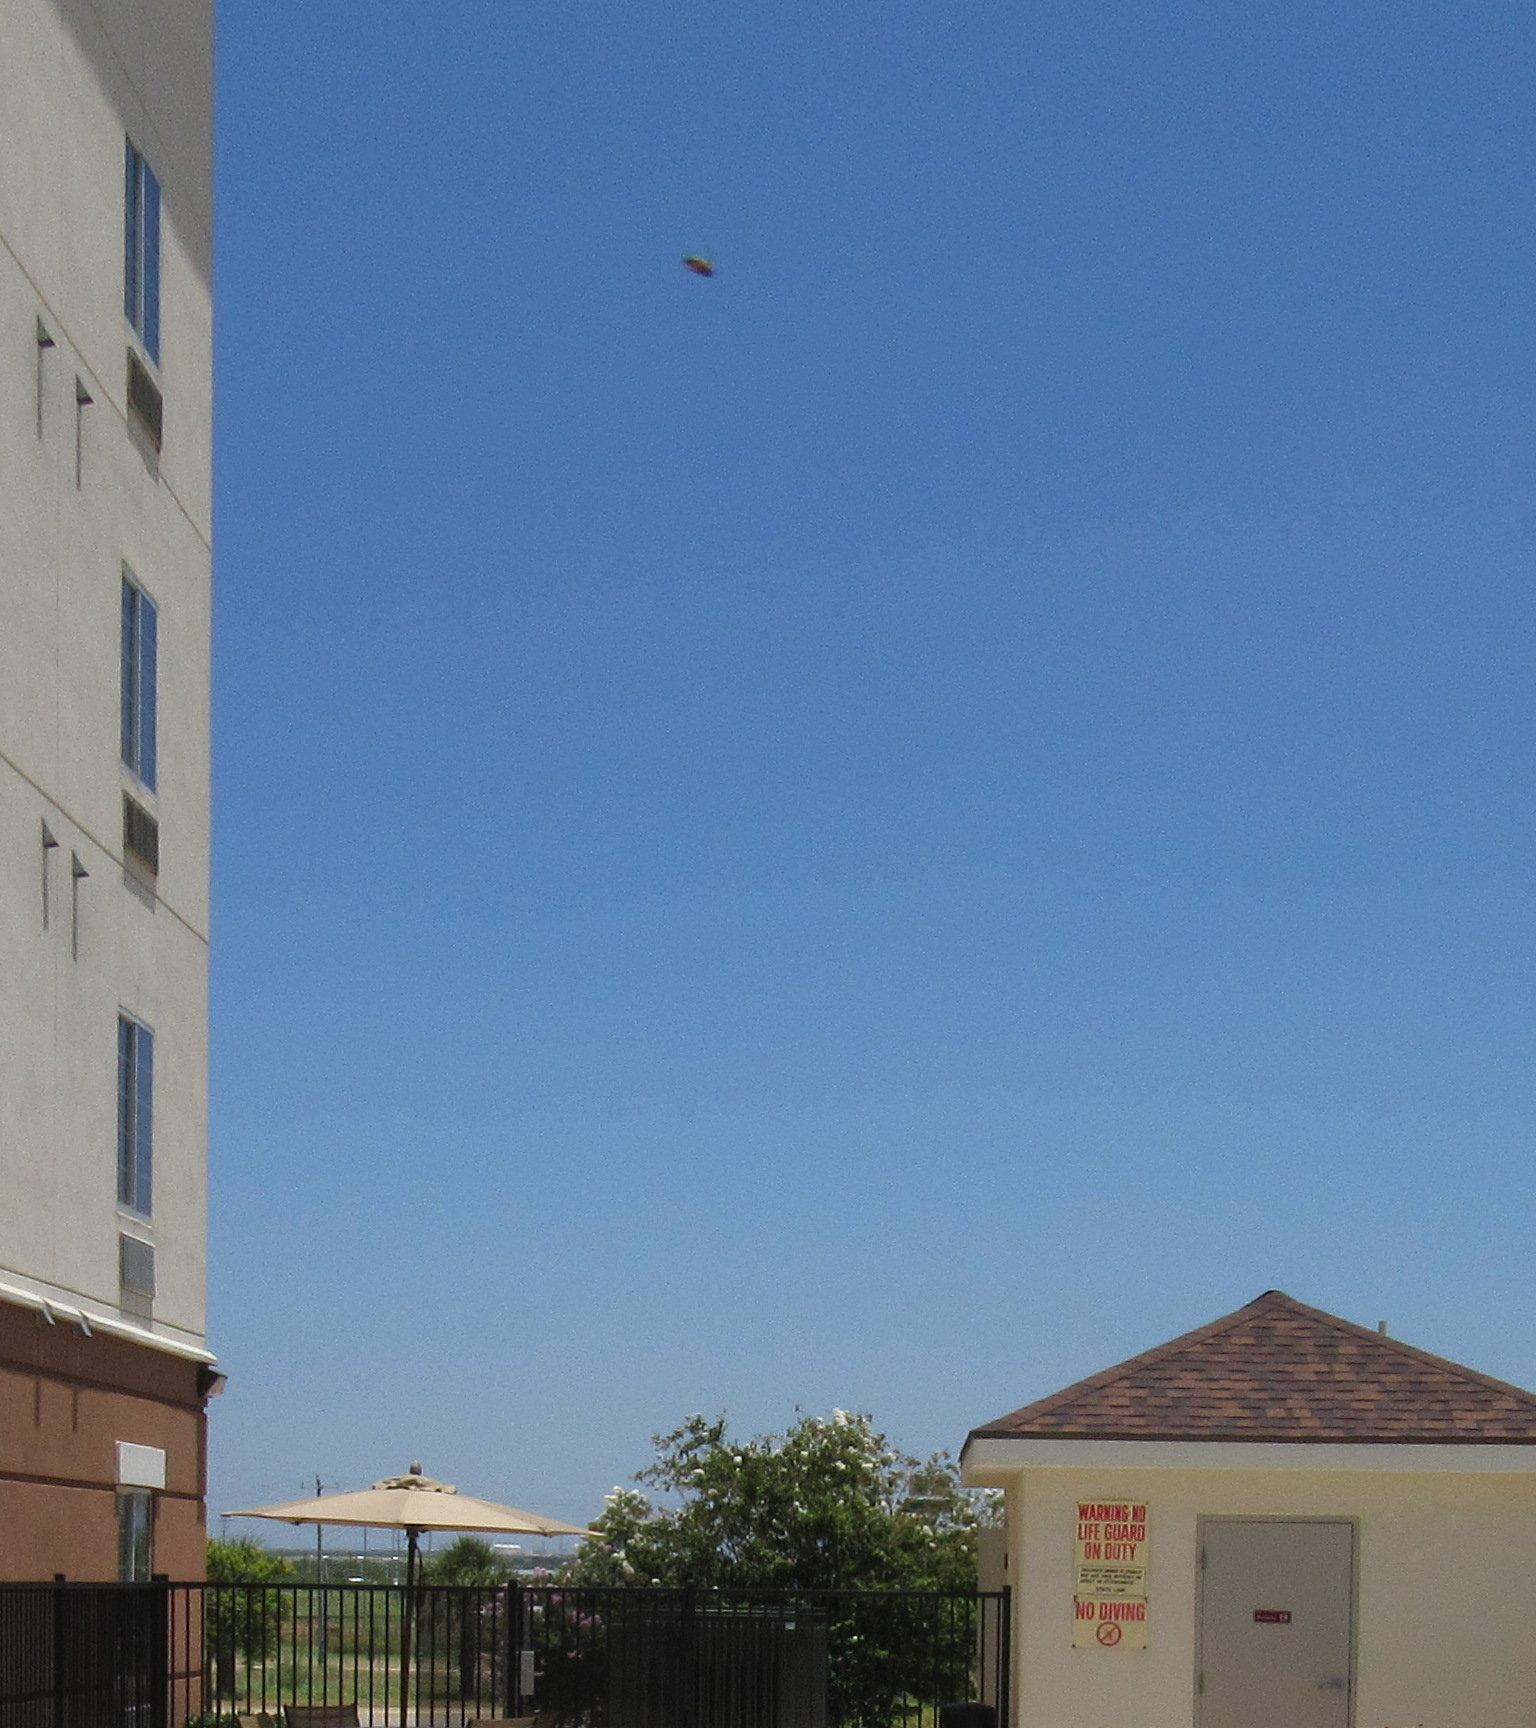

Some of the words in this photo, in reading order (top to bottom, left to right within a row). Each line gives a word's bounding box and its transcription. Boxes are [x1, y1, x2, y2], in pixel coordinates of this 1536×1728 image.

[1078, 1504, 1129, 1522] WARNING
[1131, 1505, 1146, 1523] NO
[1078, 1523, 1101, 1541] LIFE
[1104, 1523, 1146, 1542] GUARD
[1084, 1542, 1101, 1560] ON
[1104, 1543, 1137, 1561] DUTY
[1075, 1601, 1095, 1621] NO
[1099, 1602, 1146, 1622] DIVING
